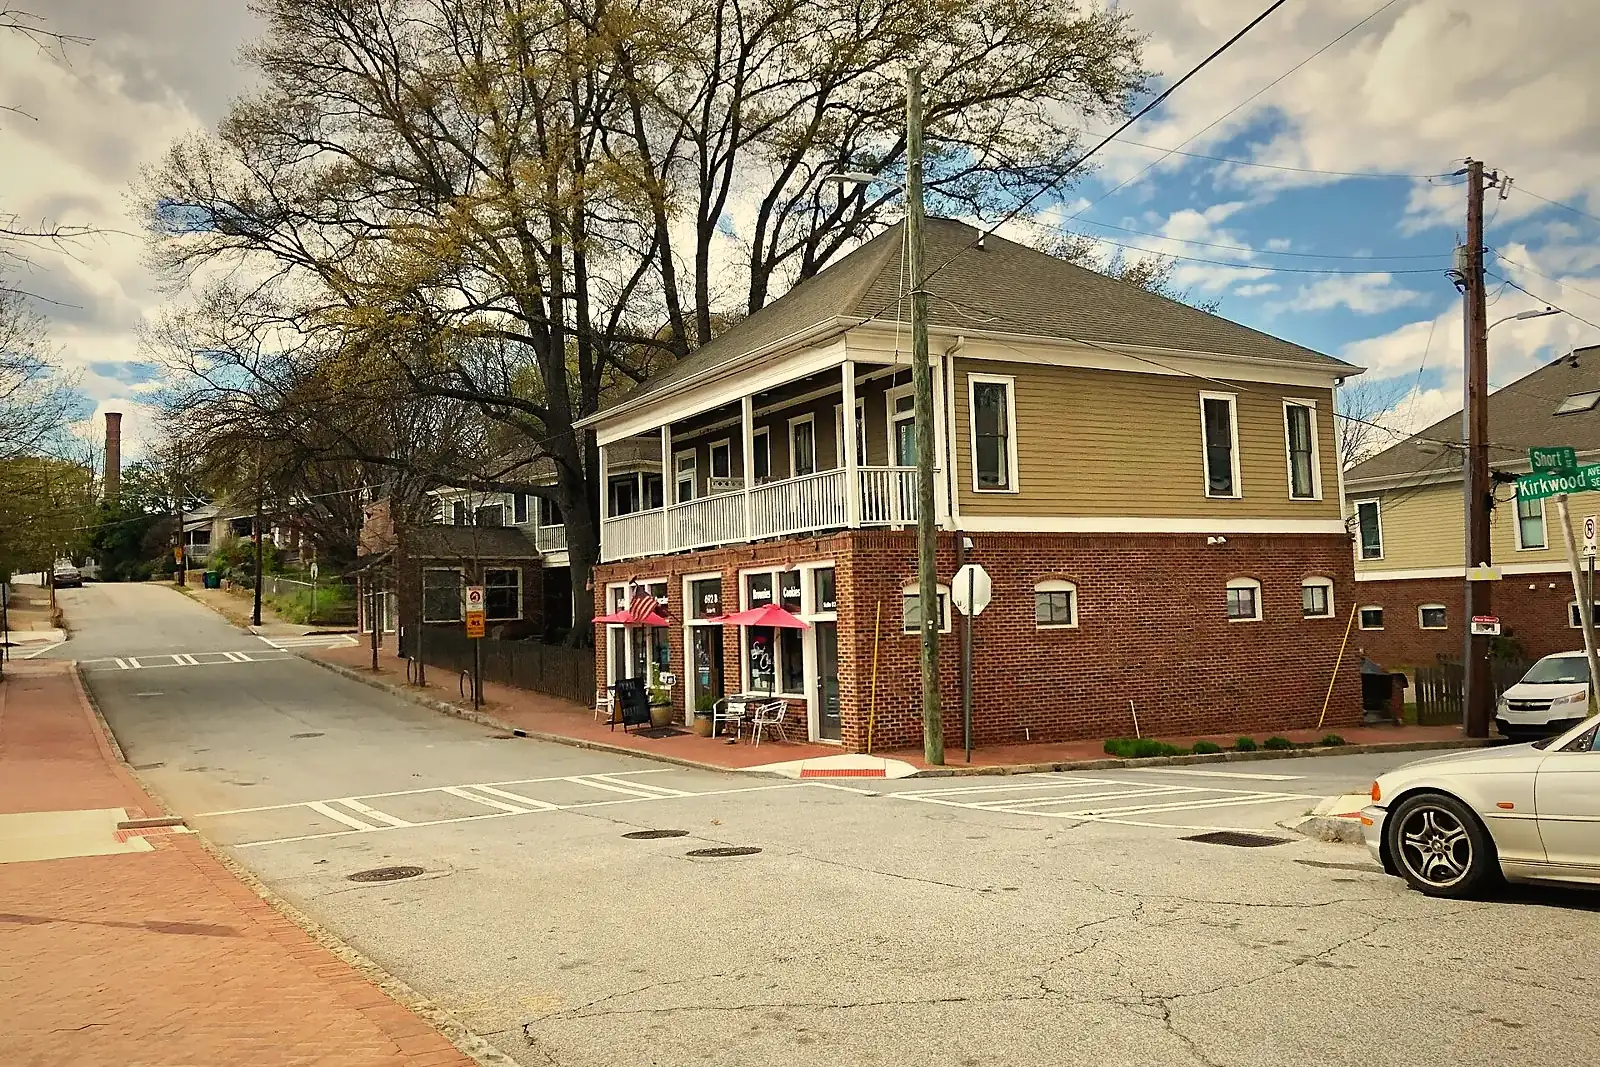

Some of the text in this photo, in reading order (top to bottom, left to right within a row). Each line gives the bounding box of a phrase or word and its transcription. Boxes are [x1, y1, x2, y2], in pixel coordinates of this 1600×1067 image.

[1534, 451, 1562, 467] Short
[1519, 466, 1600, 497] Kirkwood AVE
[1591, 477, 1600, 487] SE
[782, 586, 801, 598] Cookies
